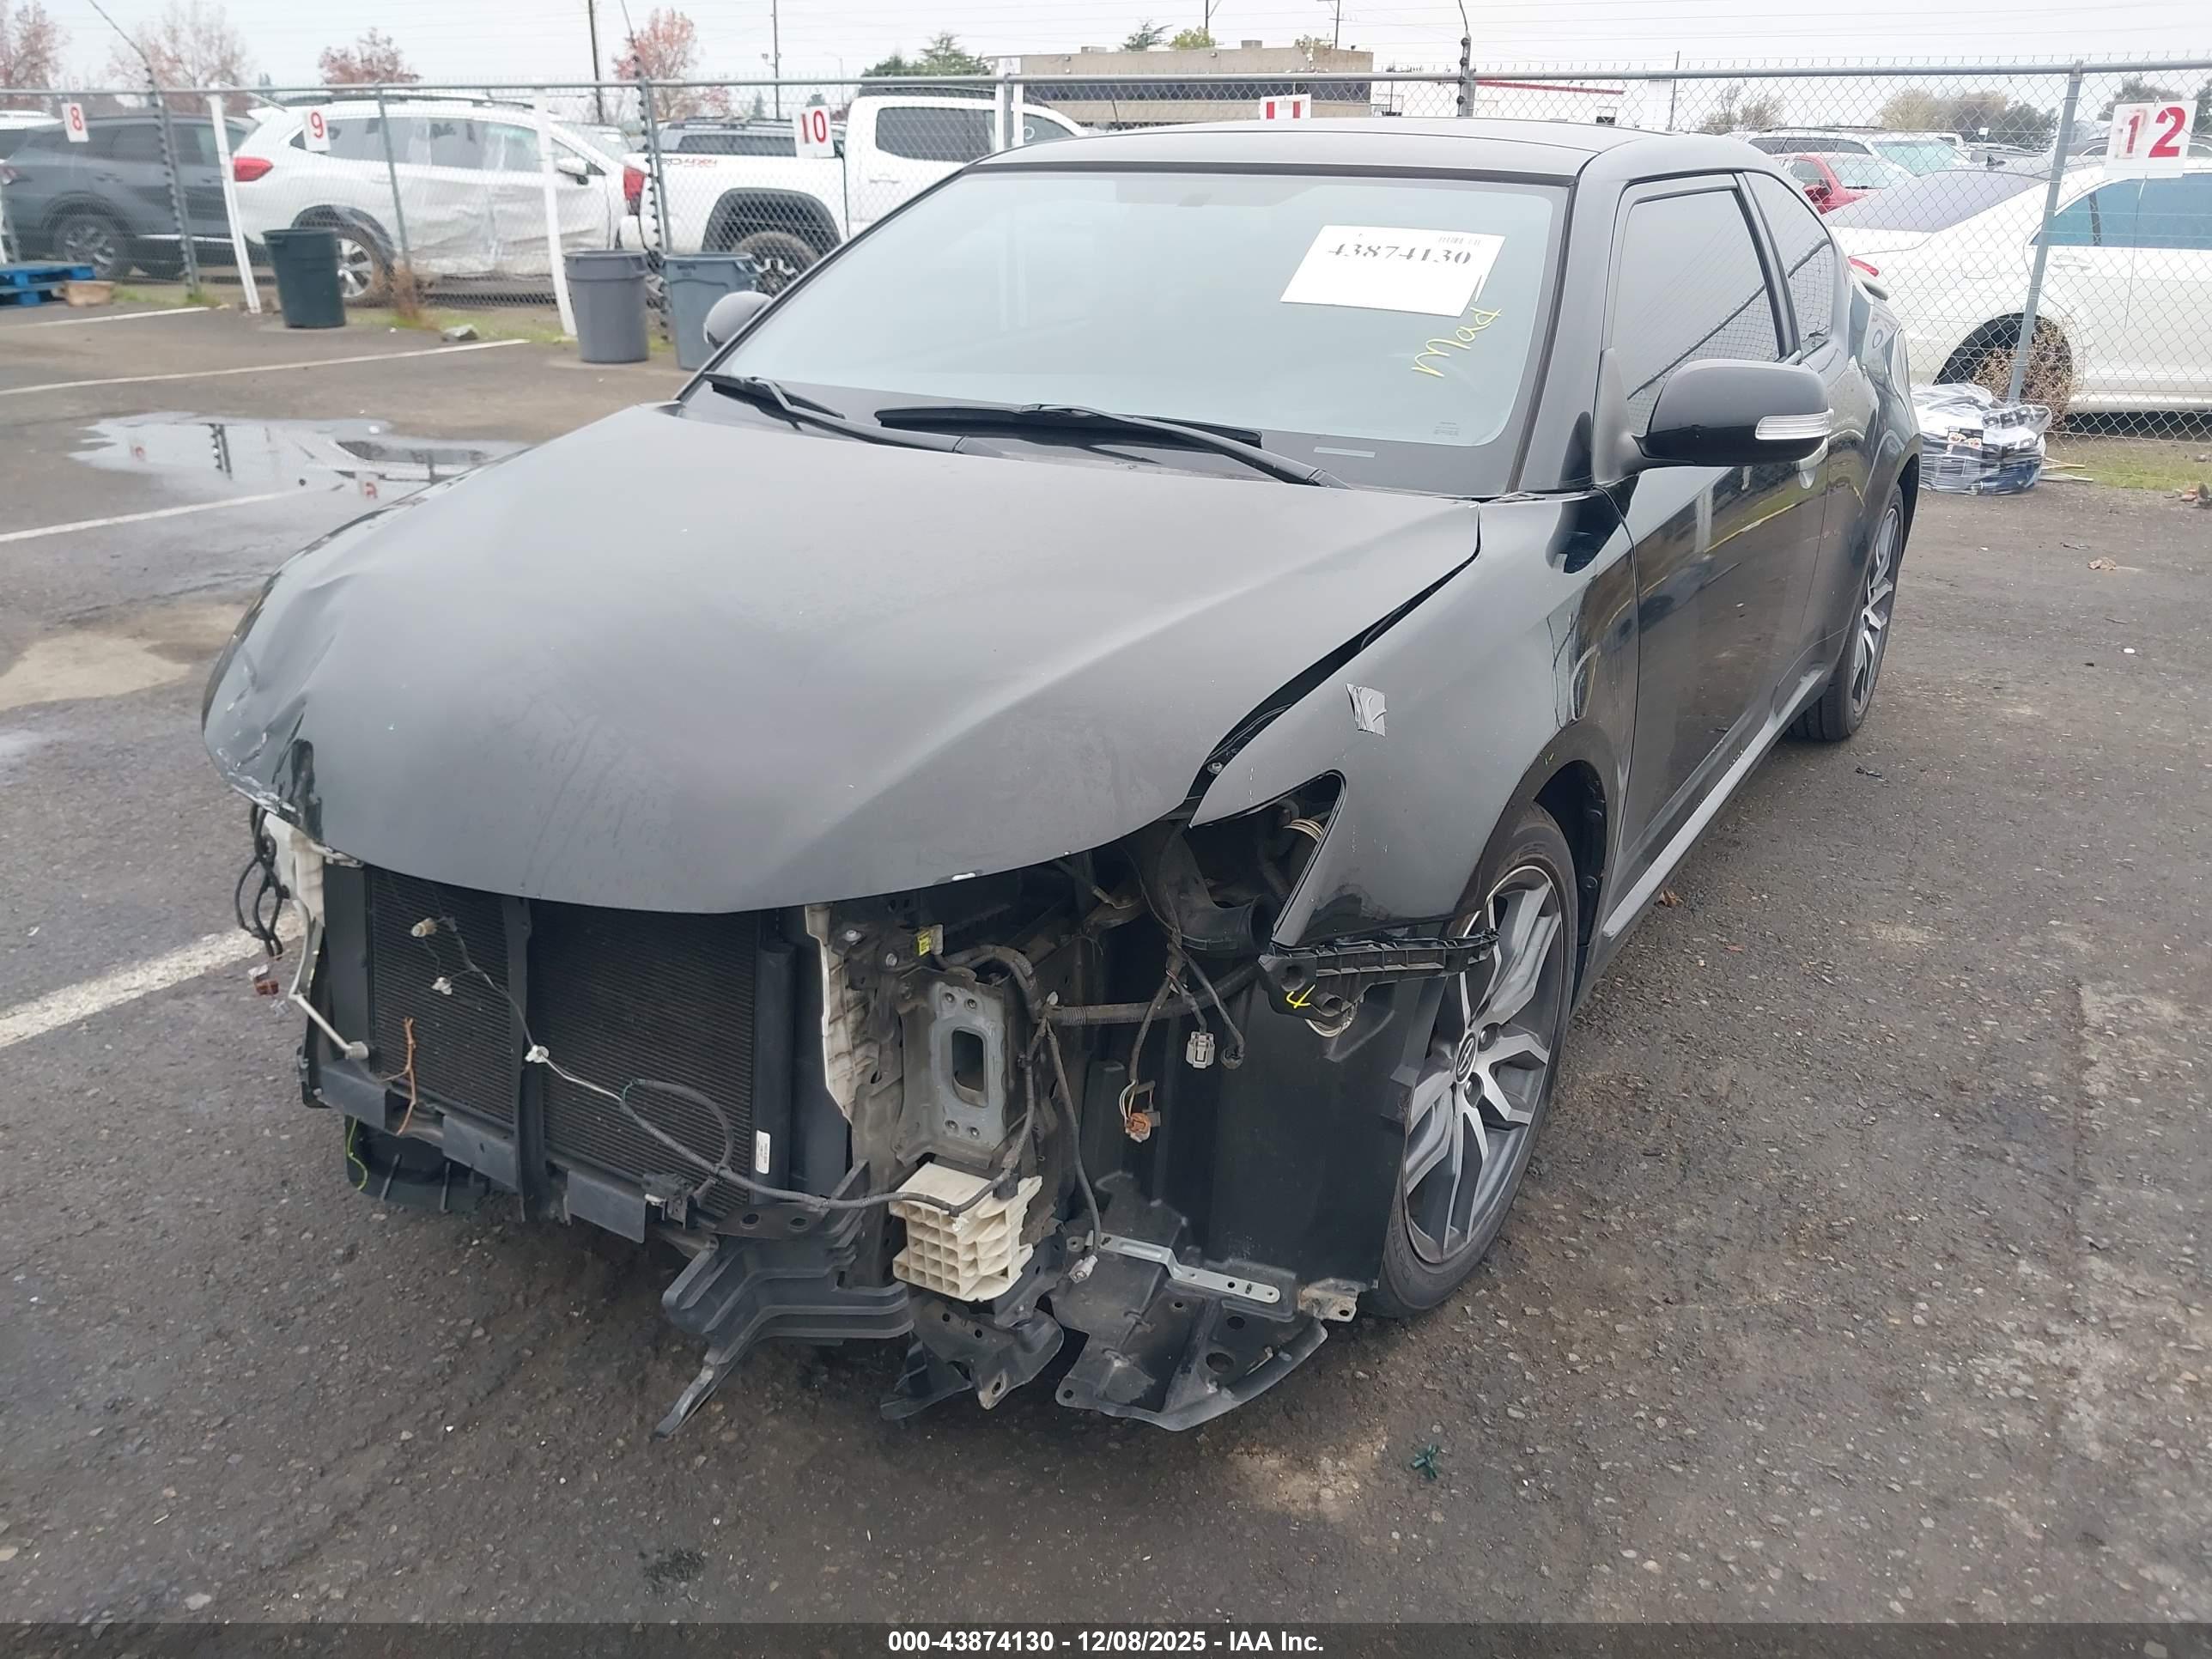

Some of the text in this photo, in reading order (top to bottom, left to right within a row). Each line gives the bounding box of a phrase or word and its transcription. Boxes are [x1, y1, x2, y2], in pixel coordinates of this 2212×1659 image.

[70, 106, 82, 131] 8
[310, 112, 324, 138] 9
[800, 110, 827, 144] 10
[2126, 106, 2186, 158] 12
[1328, 243, 1472, 264] 43874130
